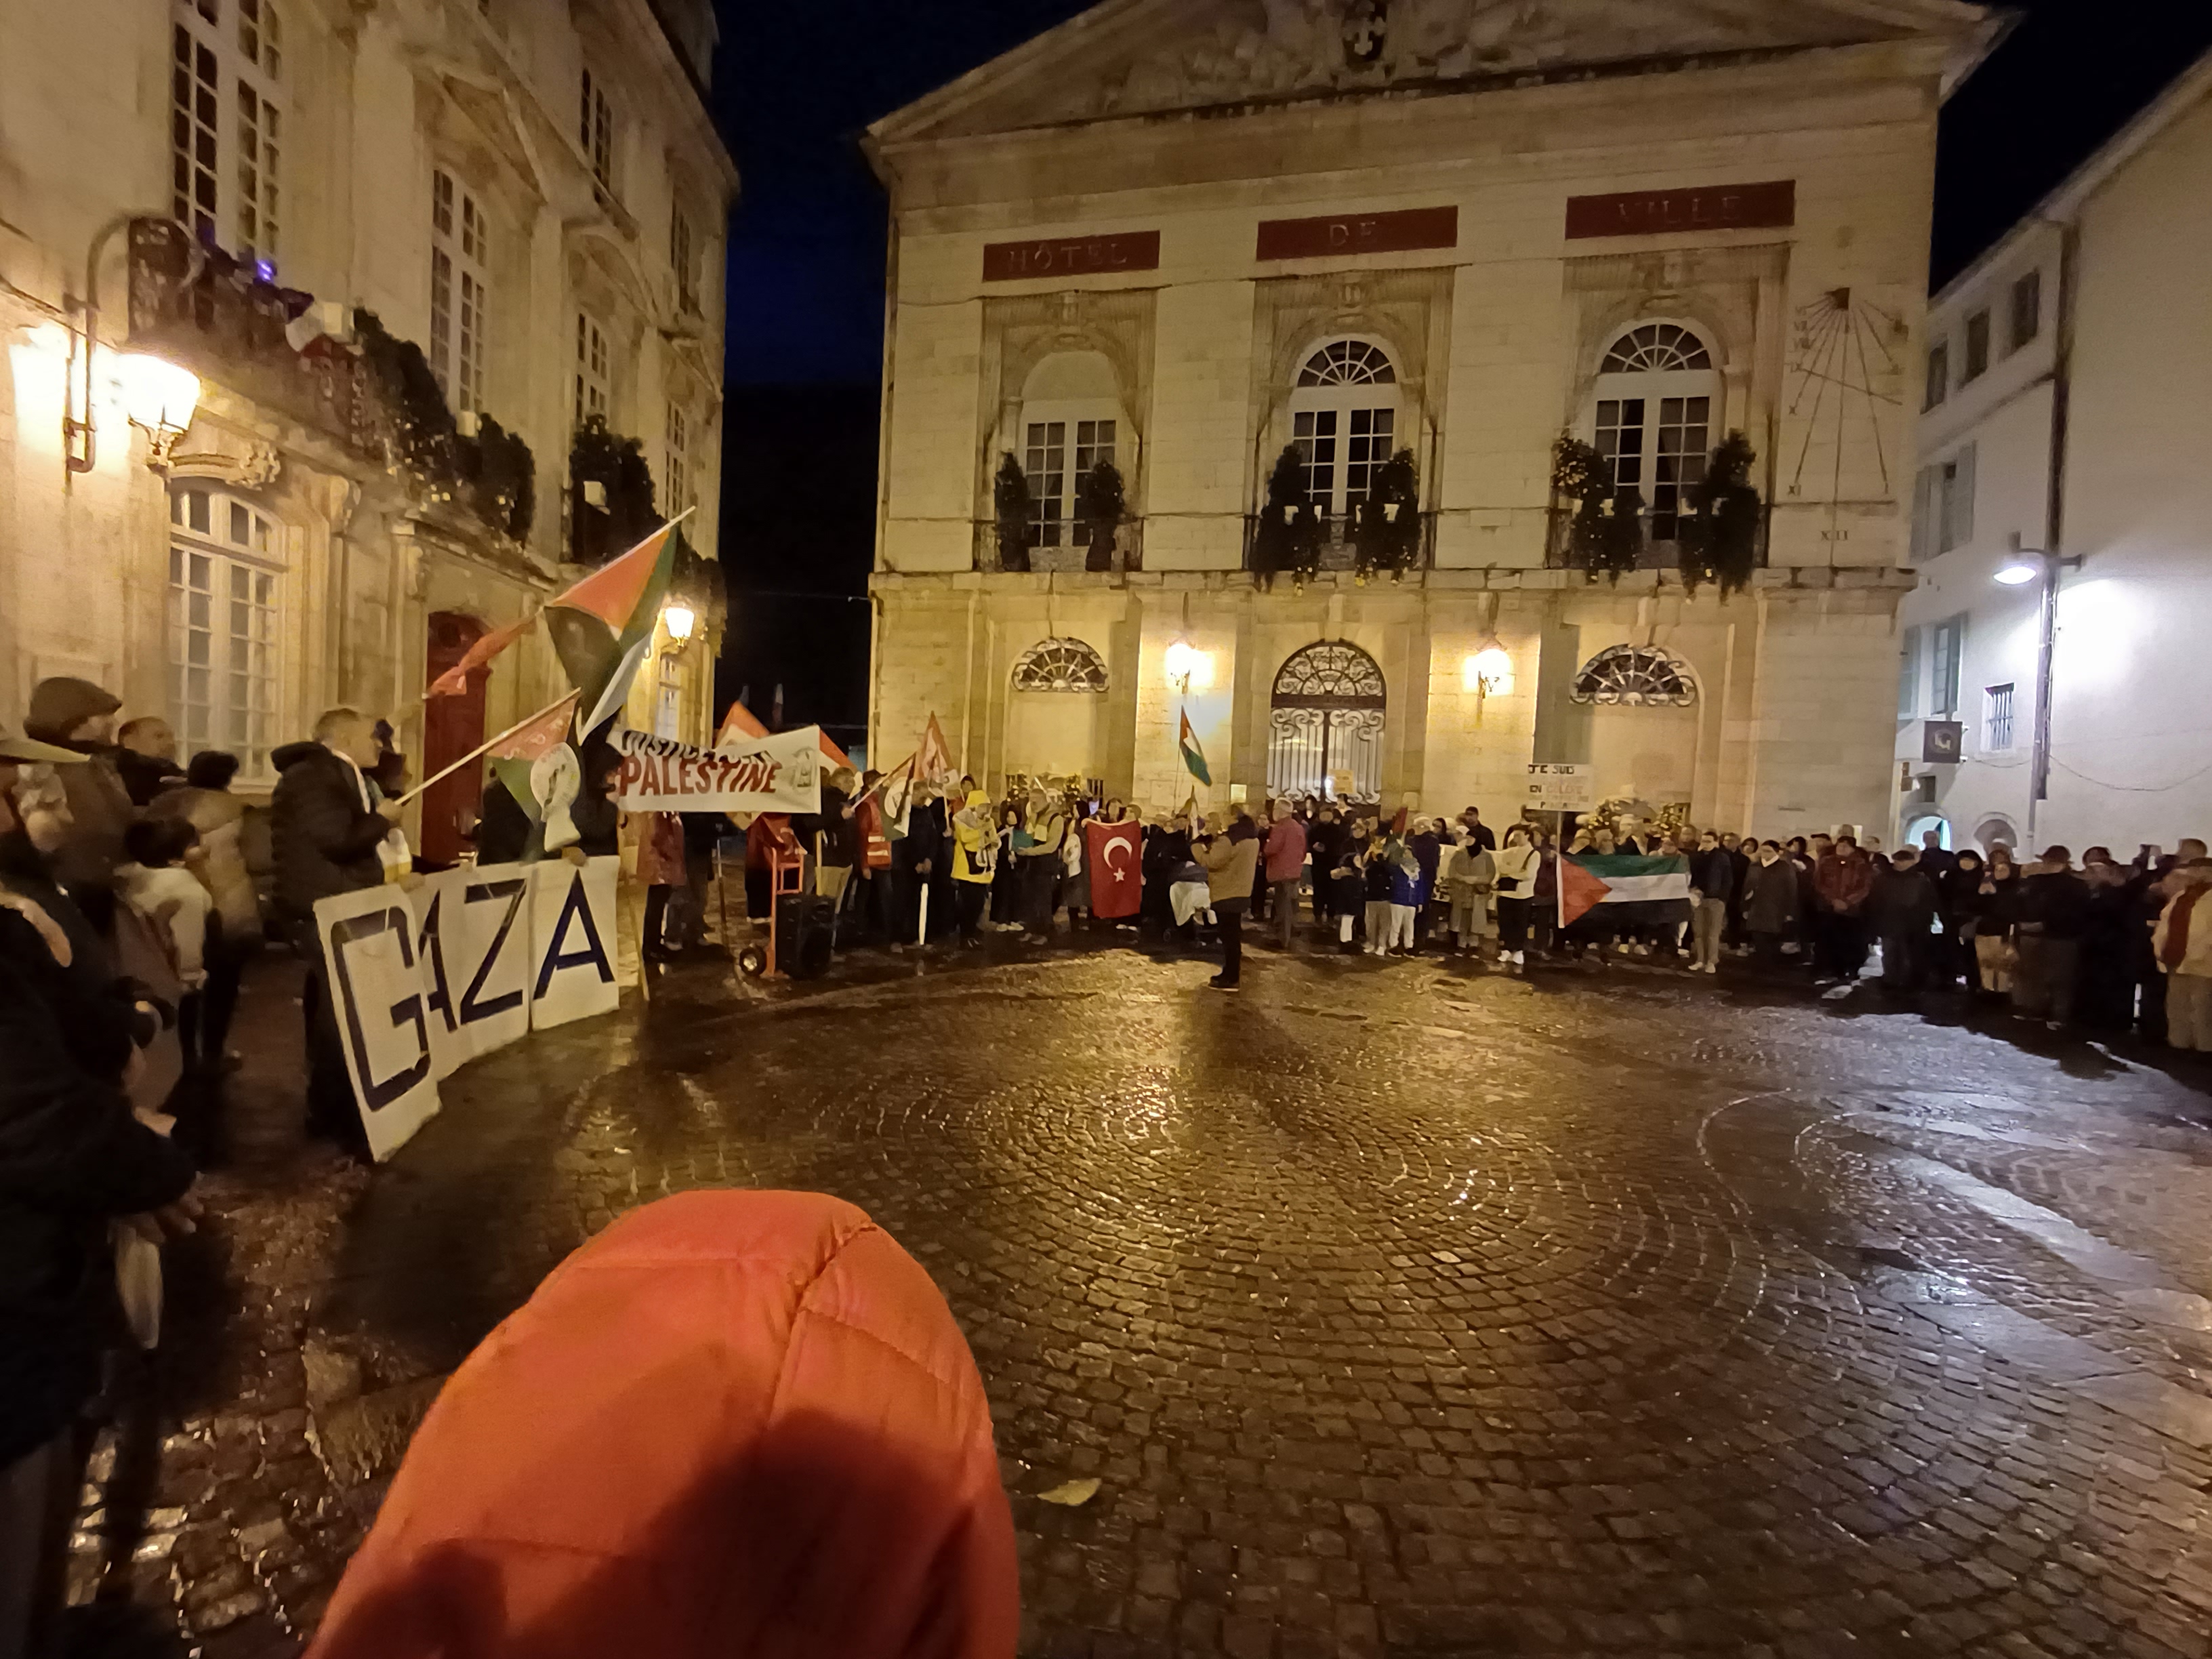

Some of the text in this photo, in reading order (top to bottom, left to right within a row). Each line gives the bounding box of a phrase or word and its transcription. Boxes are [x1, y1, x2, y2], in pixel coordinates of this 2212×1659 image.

[1328, 221, 1378, 247] DE
[619, 755, 783, 797] PALESTINE
[1528, 764, 1549, 774] JE
[1529, 784, 1542, 794] EN
[331, 869, 616, 1112] GAZA
